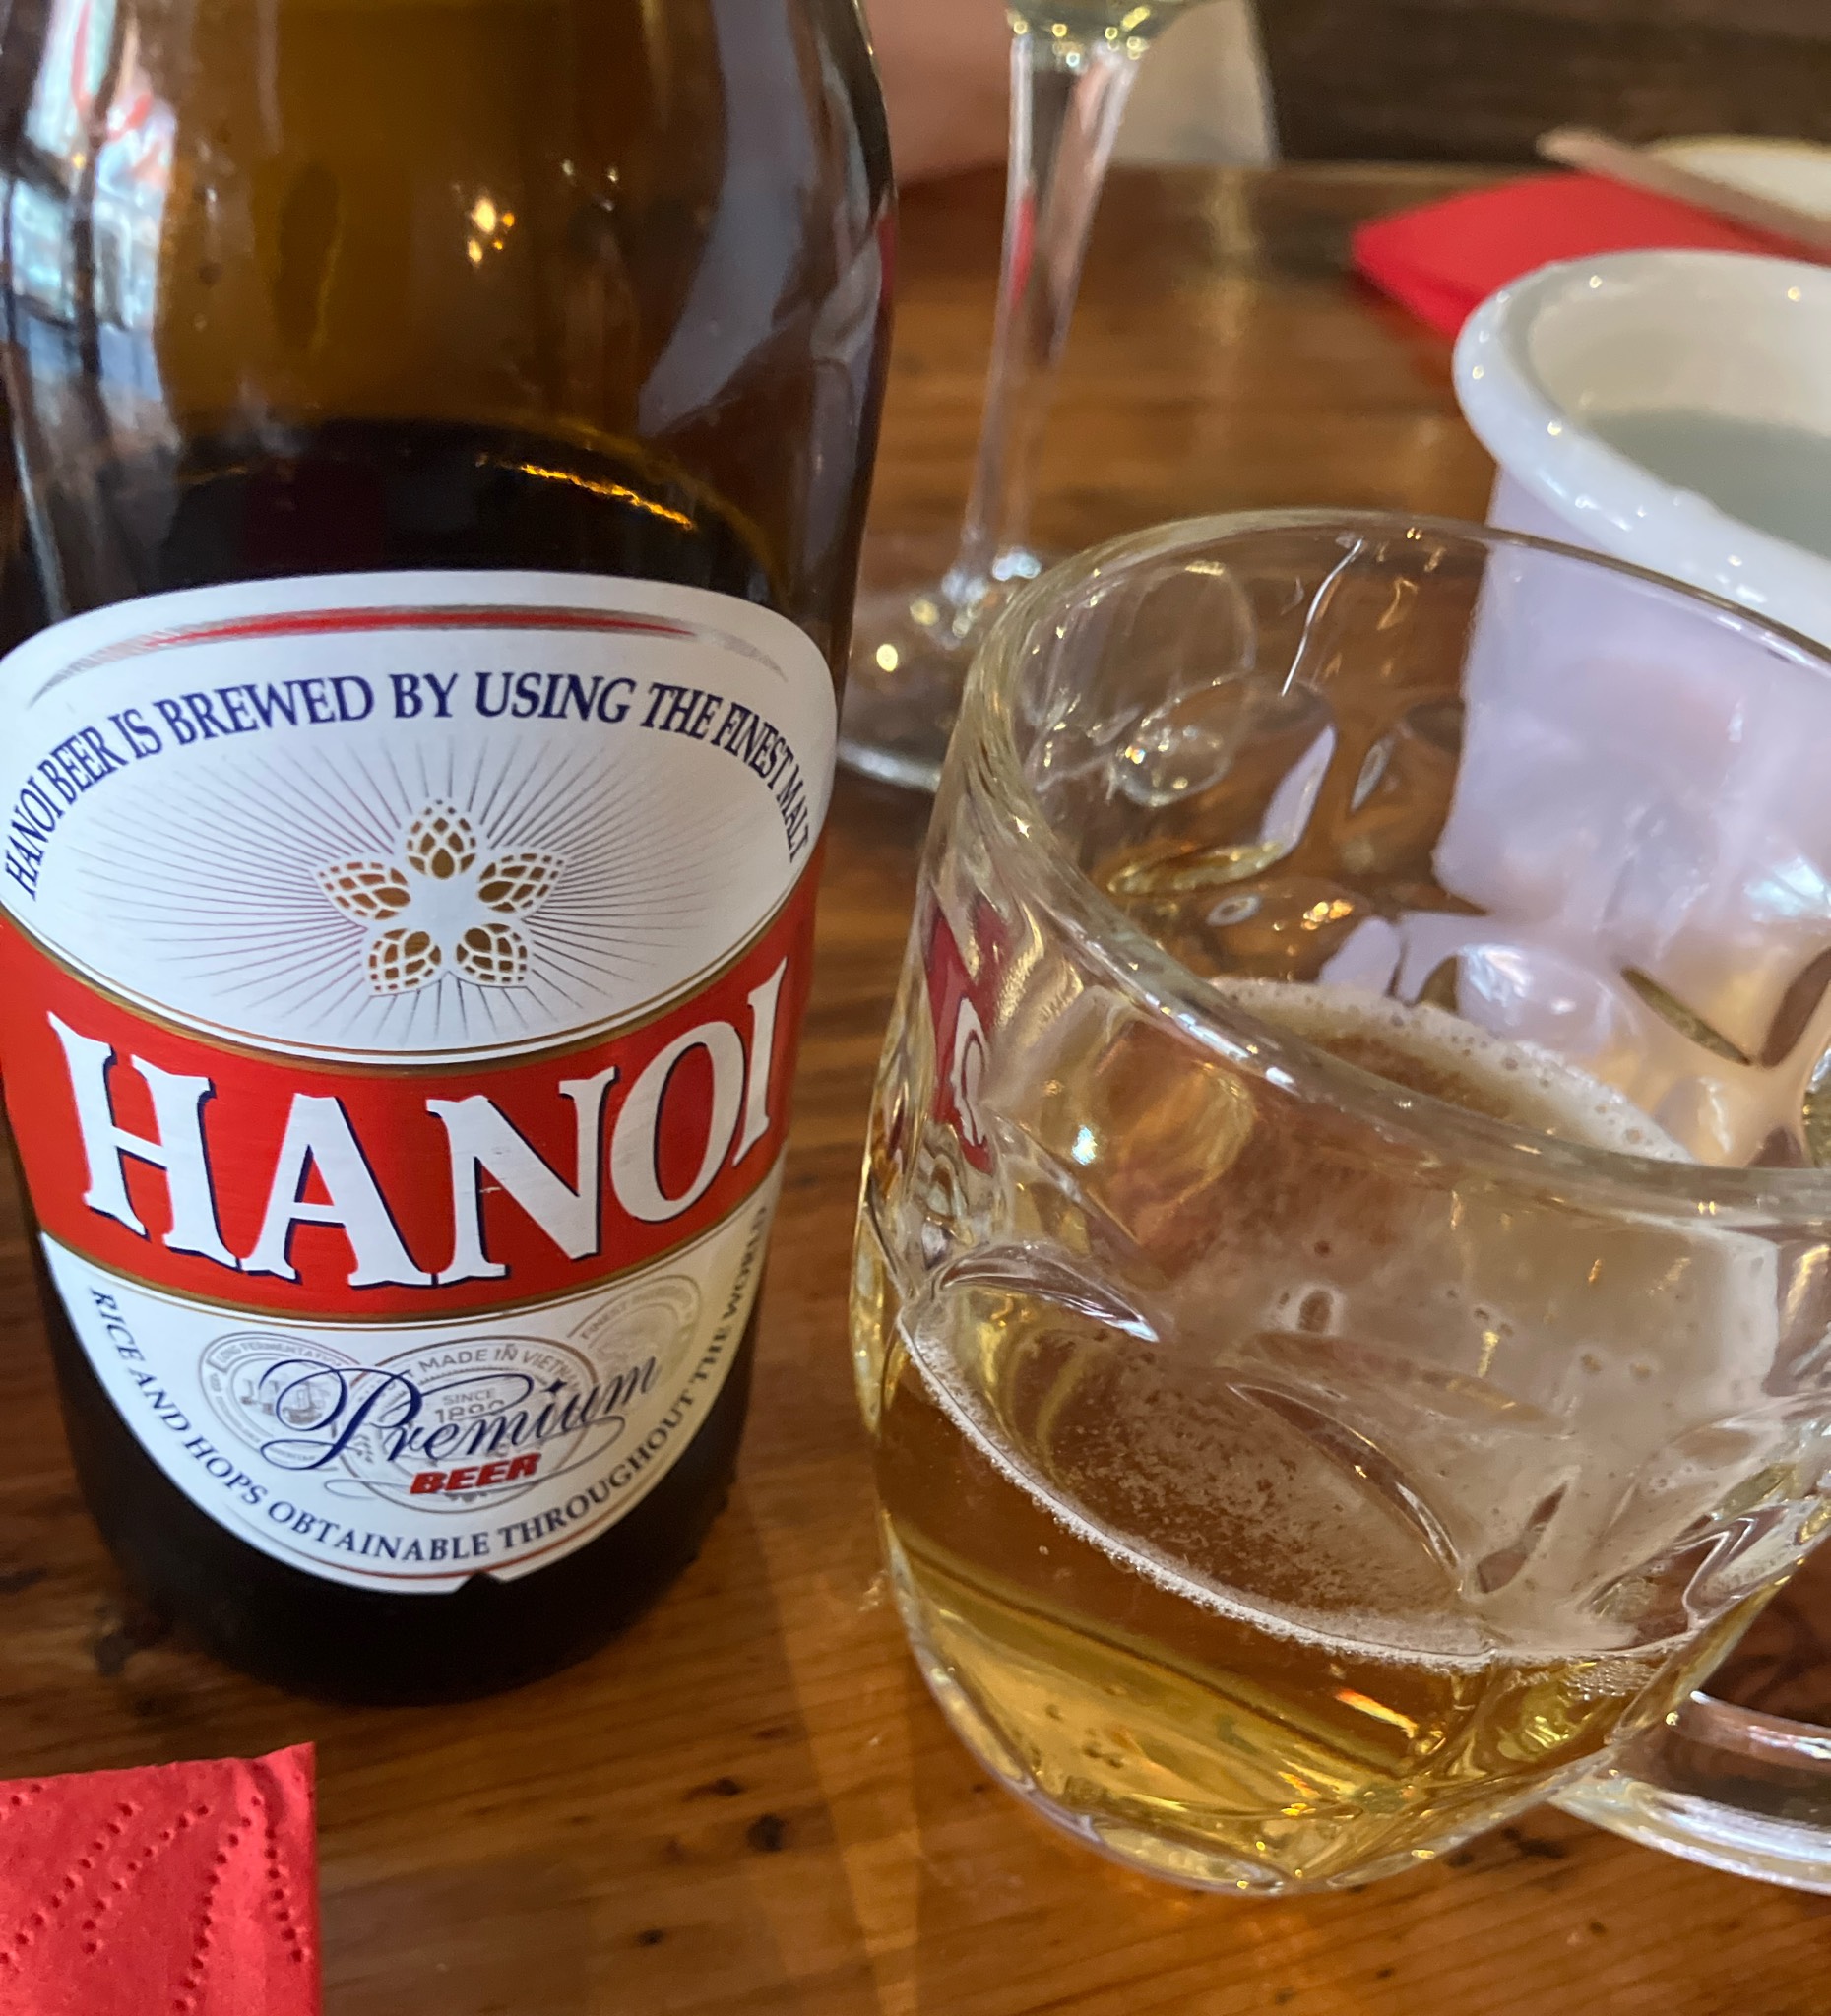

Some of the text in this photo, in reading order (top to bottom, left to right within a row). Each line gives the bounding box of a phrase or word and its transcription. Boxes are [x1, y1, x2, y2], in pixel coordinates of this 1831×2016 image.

[6, 671, 810, 901] HANOI BEER IS BREWED BY USING THE FINEST MALT
[47, 957, 789, 1290] HANOI
[258, 1356, 662, 1471] Premium
[419, 1348, 487, 1374] MADE
[494, 1344, 518, 1361] IN
[442, 1388, 496, 1406] SINCE
[91, 1288, 146, 1362] RICE
[127, 1368, 192, 1433] AND
[184, 1434, 269, 1506] HOPS
[267, 1501, 491, 1562] OBTAINABLE
[497, 1389, 695, 1551] THROUGHOUT
[688, 1326, 731, 1384] THE
[410, 1452, 542, 1495] BEER
